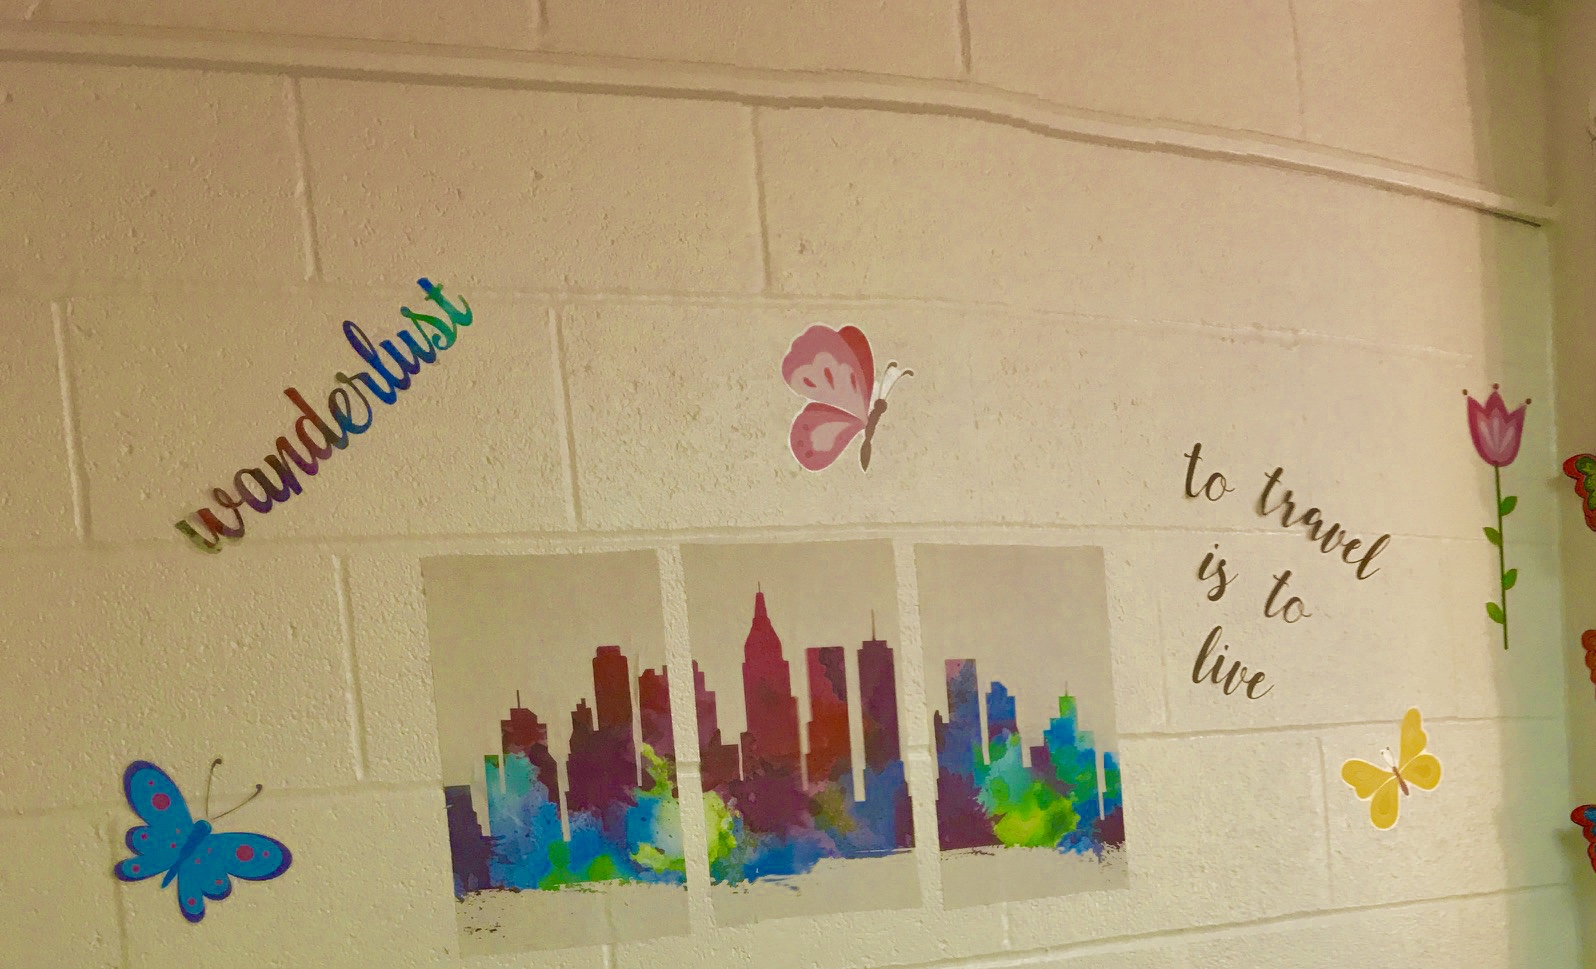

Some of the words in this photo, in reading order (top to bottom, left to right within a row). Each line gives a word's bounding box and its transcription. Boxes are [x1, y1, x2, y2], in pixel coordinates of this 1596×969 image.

[174, 277, 473, 554] wanderlust
[1183, 442, 1235, 501] to
[1258, 466, 1391, 580] travel
[1198, 543, 1238, 601] is
[1263, 570, 1312, 623] to
[1191, 625, 1275, 700] live
